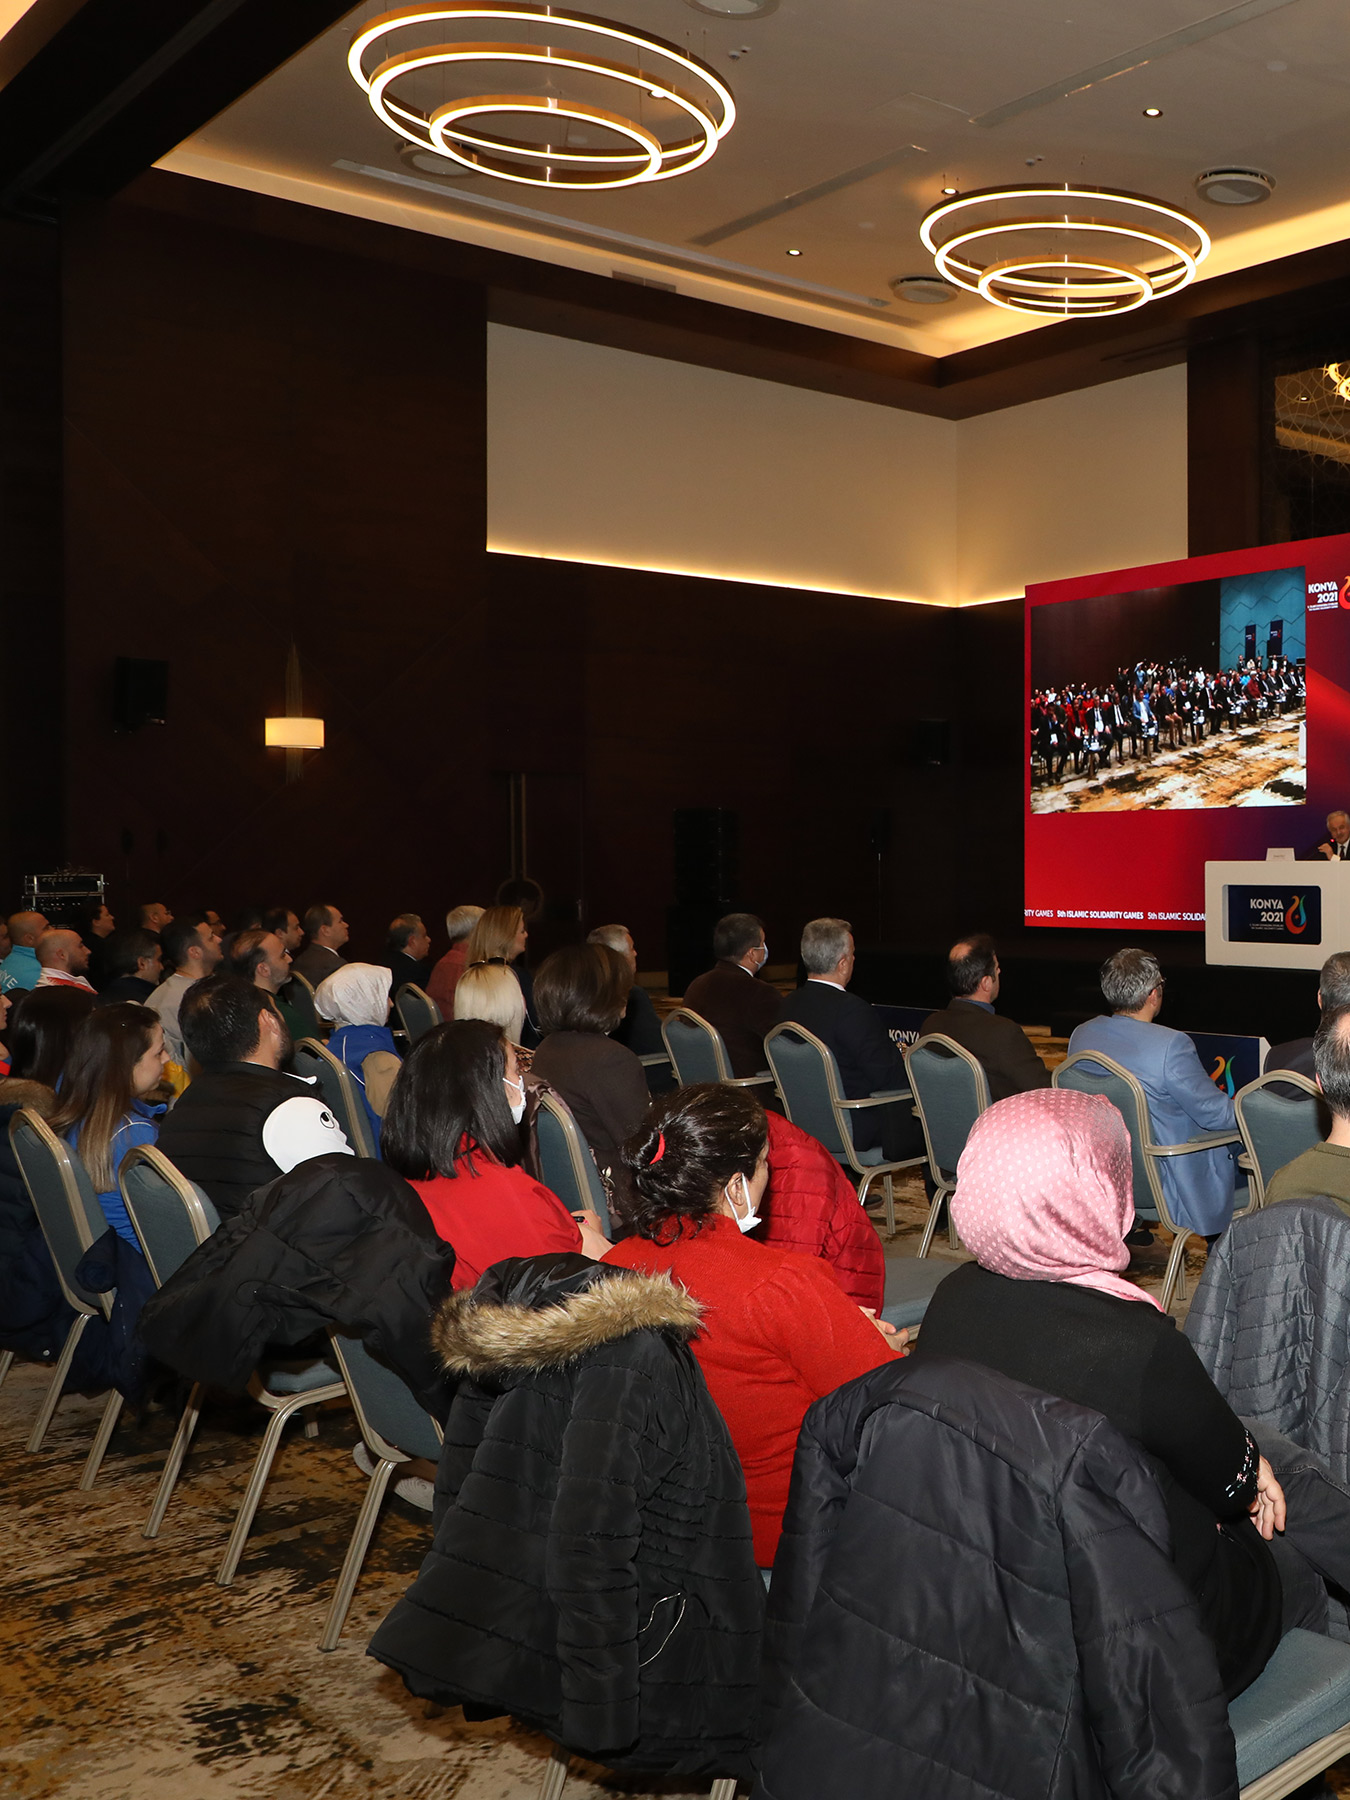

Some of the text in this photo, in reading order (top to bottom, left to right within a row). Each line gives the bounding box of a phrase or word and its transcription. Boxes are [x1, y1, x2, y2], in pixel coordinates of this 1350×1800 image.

[1308, 581, 1338, 594] KONYA
[1317, 591, 1338, 603] 2021
[1250, 898, 1284, 910] KONYA
[1035, 909, 1054, 918] GAMES
[1057, 910, 1066, 918] 5th
[1066, 910, 1089, 919] ISLAMIC
[1089, 910, 1123, 919] SOLIDARITY
[1123, 911, 1144, 920] GAMES
[1147, 911, 1157, 920] 5th
[1158, 911, 1182, 921] ISLAMIC
[1260, 911, 1284, 922] 2021
